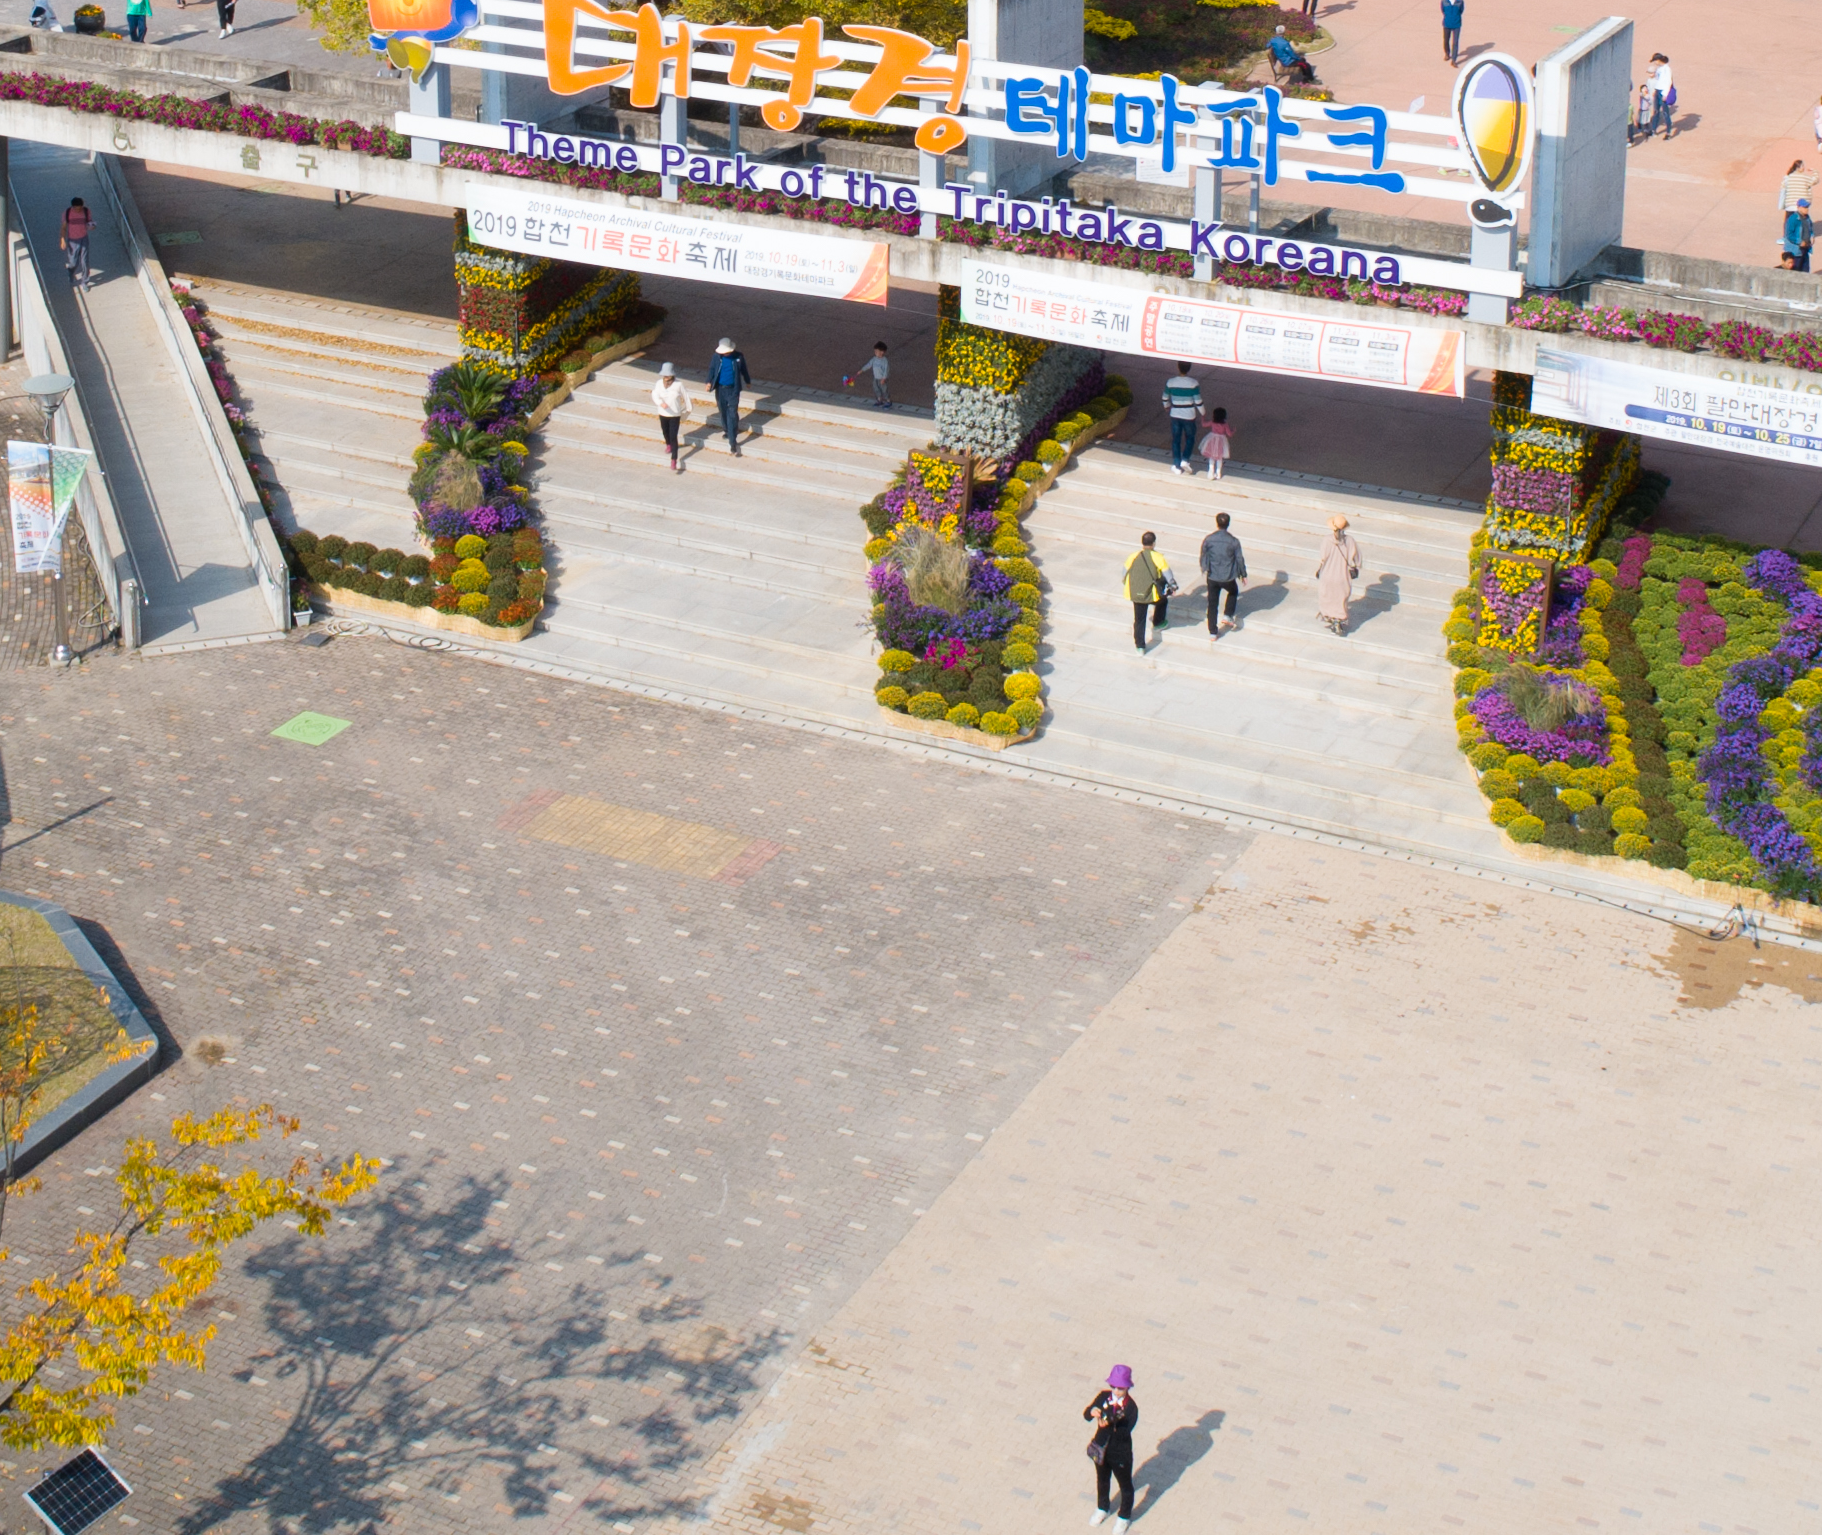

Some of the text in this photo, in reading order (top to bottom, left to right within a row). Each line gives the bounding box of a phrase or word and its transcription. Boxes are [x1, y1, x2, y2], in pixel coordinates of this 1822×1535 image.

[1004, 65, 1407, 195] 테마파크
[472, 209, 518, 238] 2019
[499, 119, 1402, 287] Theme Park of the Tripitaka Koreana
[527, 200, 744, 244] 2019 Hapcheon Archival Cultural Festival
[975, 268, 1010, 288] 2019
[1652, 385, 1697, 413] 제3회
[1706, 394, 1819, 433] 팔만대장경
